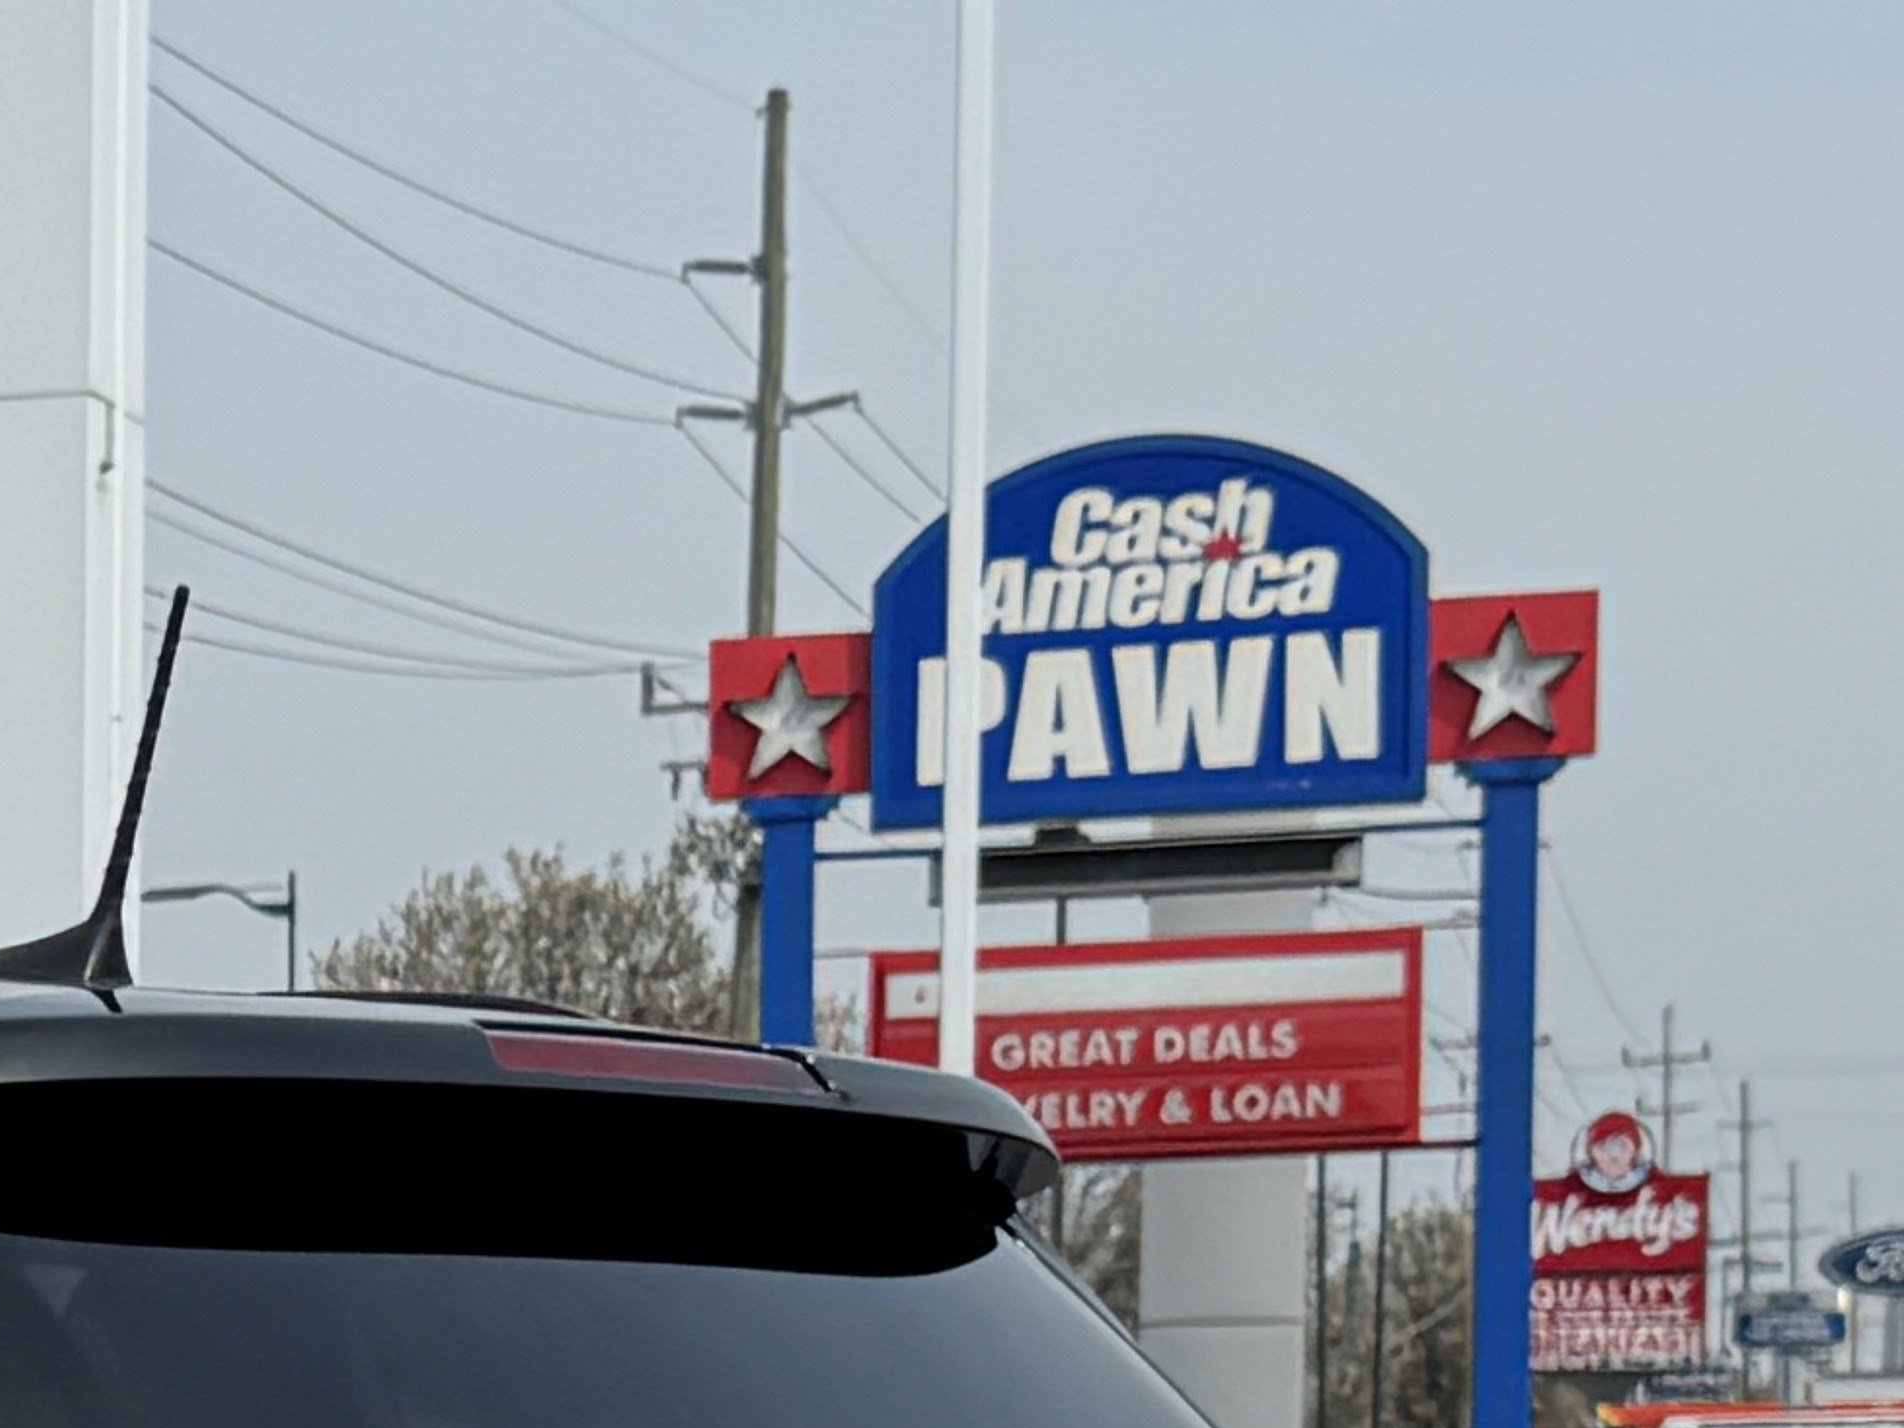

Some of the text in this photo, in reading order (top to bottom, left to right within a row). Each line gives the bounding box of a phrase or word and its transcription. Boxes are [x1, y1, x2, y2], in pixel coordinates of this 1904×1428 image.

[1051, 476, 1275, 567] Cash
[982, 547, 1340, 636] America
[917, 627, 1379, 787] PAWN
[991, 1019, 1299, 1072] GREAT DEALS
[1160, 1088, 1192, 1125] &
[1210, 1081, 1343, 1123] LOAN
[1530, 1185, 1700, 1260] Wendy's
[1530, 1276, 1692, 1310] QUALITY
